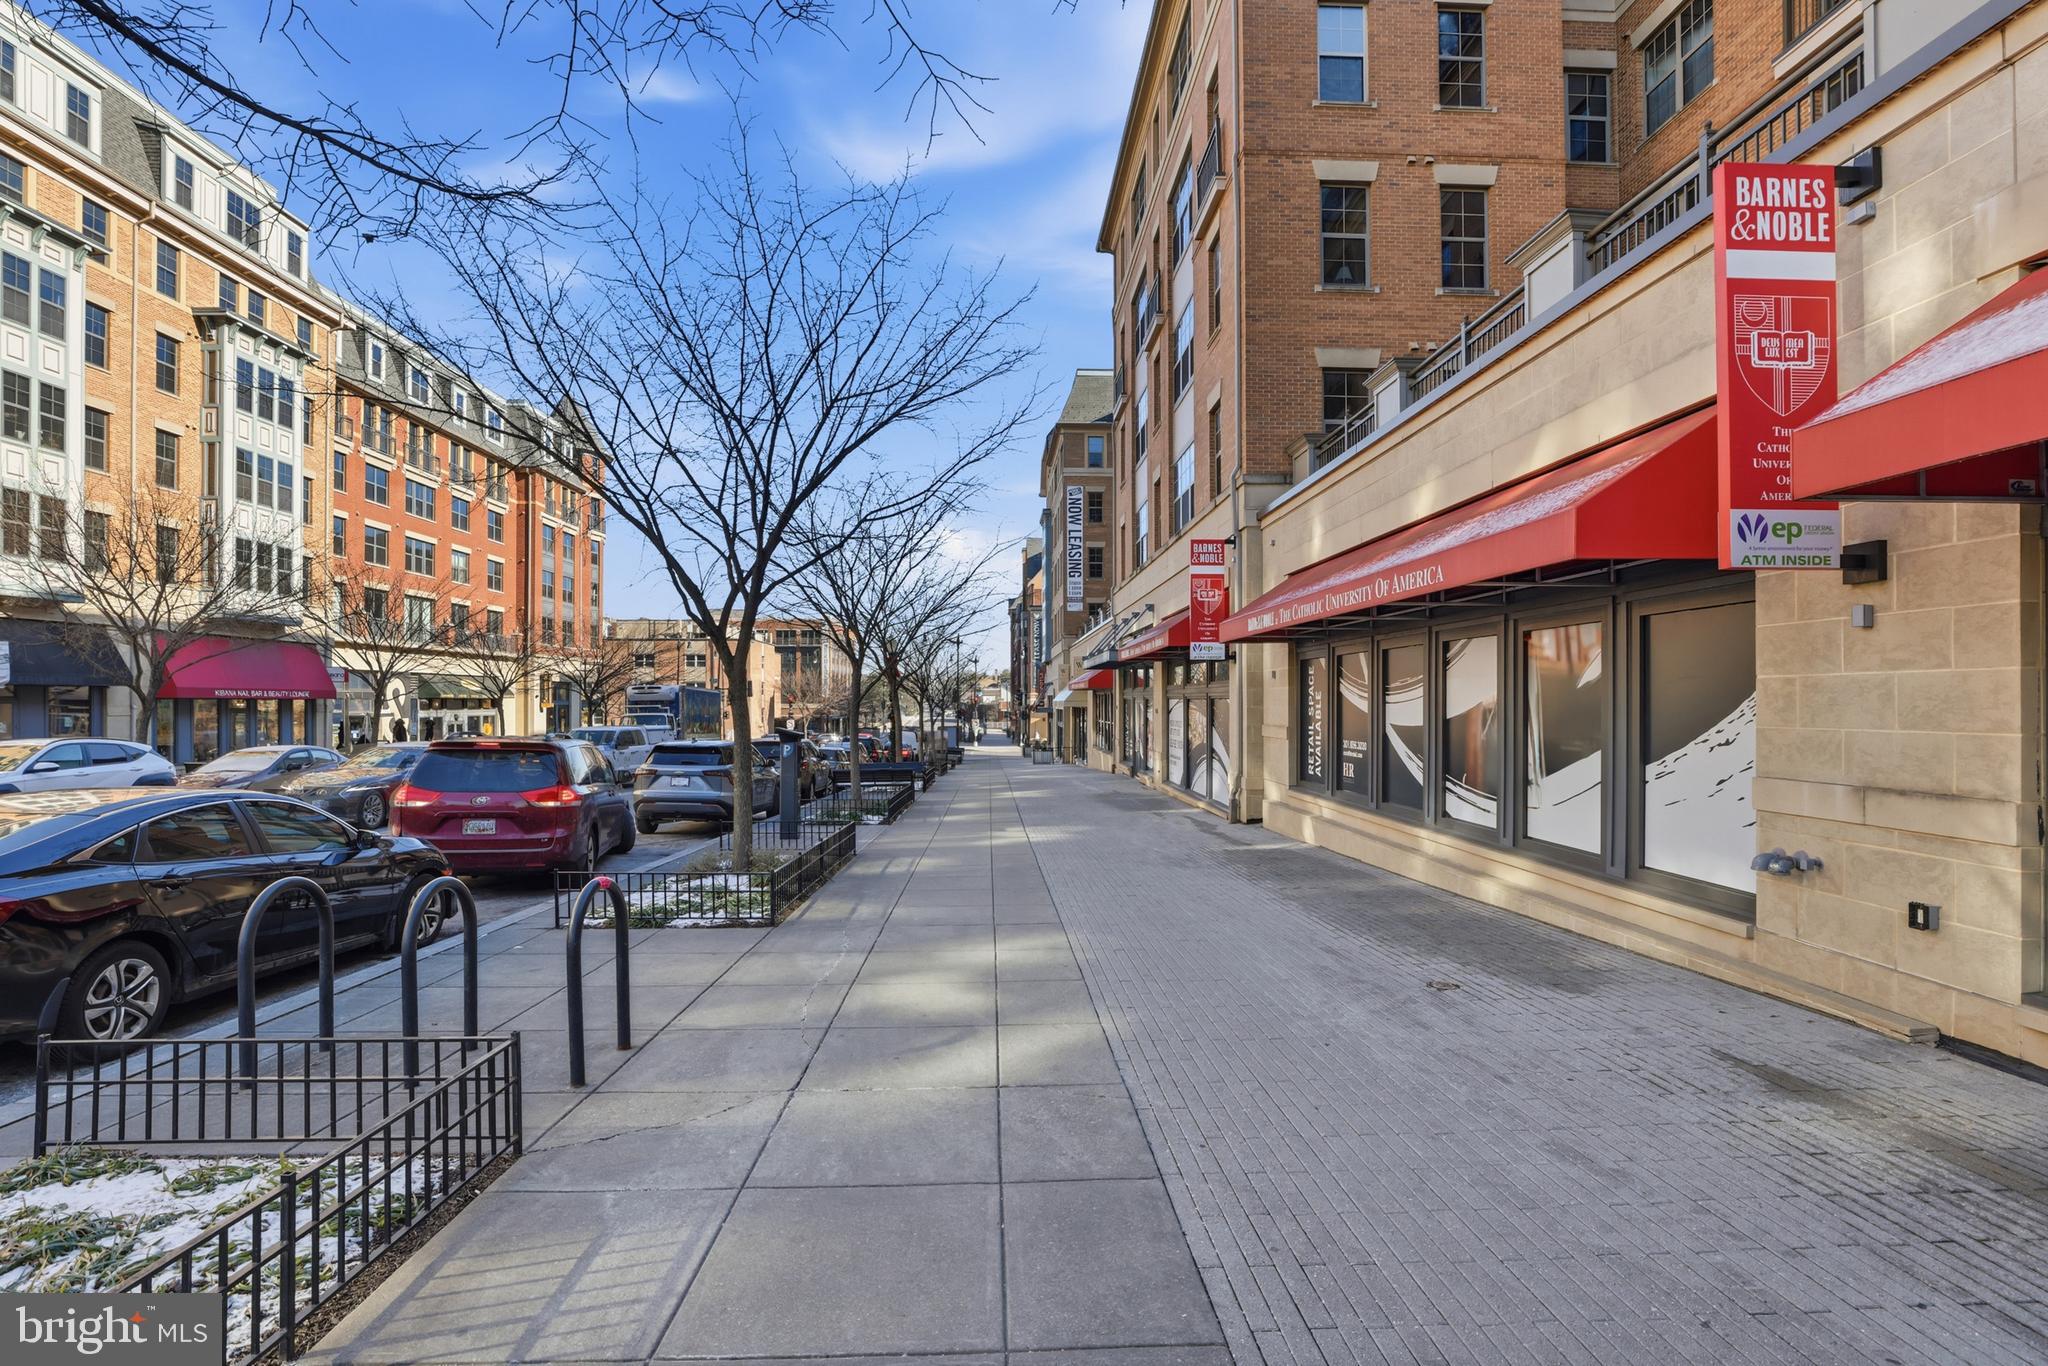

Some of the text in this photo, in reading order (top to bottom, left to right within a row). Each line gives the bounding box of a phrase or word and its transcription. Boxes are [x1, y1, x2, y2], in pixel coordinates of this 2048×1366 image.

[1736, 176, 1826, 209] BARNES
[1765, 347, 1780, 358] LUX
[1757, 442, 1791, 453] CATHO
[1752, 458, 1792, 469] UNIVER
[1760, 491, 1792, 501] AMER
[1068, 498, 1082, 526] NOW
[1771, 522, 1802, 544] ep
[1068, 529, 1082, 578] LEASING
[1193, 543, 1222, 553] BARNES
[1741, 555, 1831, 566] ATM INSIDE
[1292, 599, 1324, 620] CATHOLIC
[1325, 584, 1374, 611] UNIVERSITY
[1375, 578, 1390, 599] OF
[1391, 565, 1444, 593] AMERICA
